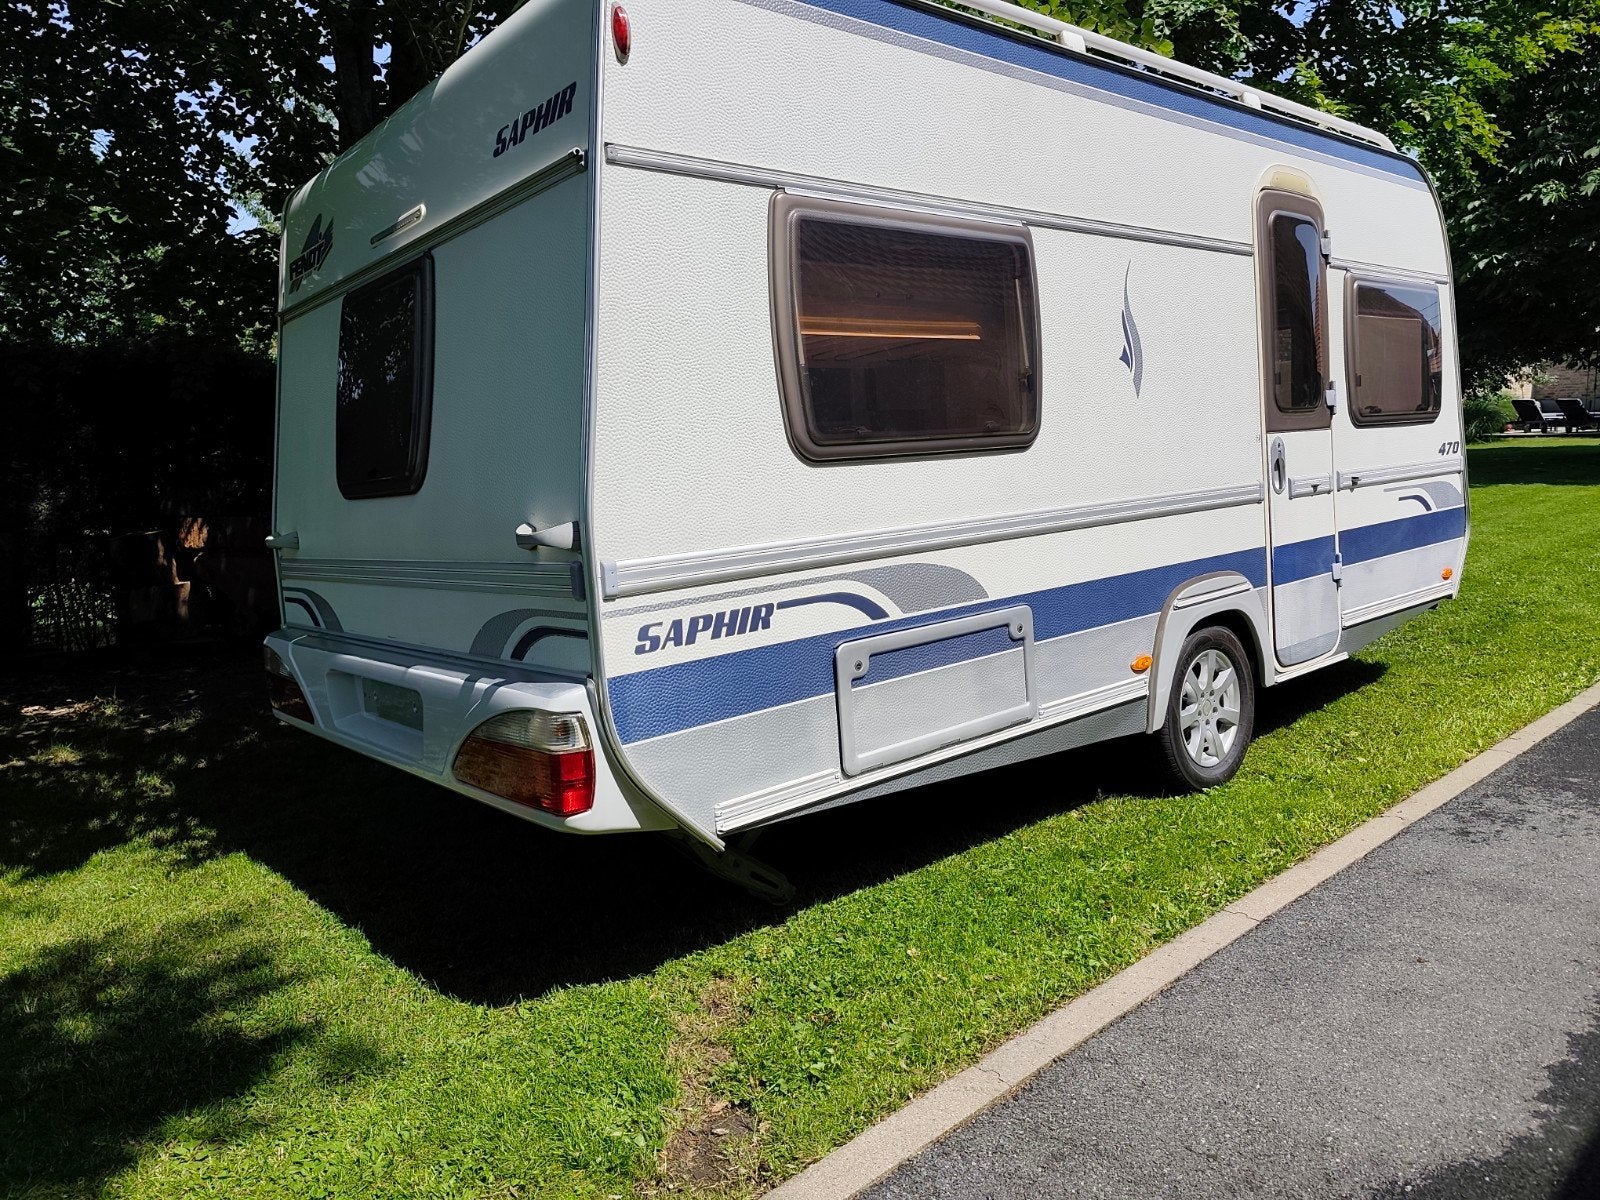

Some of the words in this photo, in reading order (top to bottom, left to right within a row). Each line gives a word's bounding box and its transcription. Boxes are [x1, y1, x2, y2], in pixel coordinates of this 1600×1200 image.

[493, 81, 577, 158] SAPHIR
[1438, 441, 1460, 456] 470
[634, 602, 775, 656] SAPHIR
